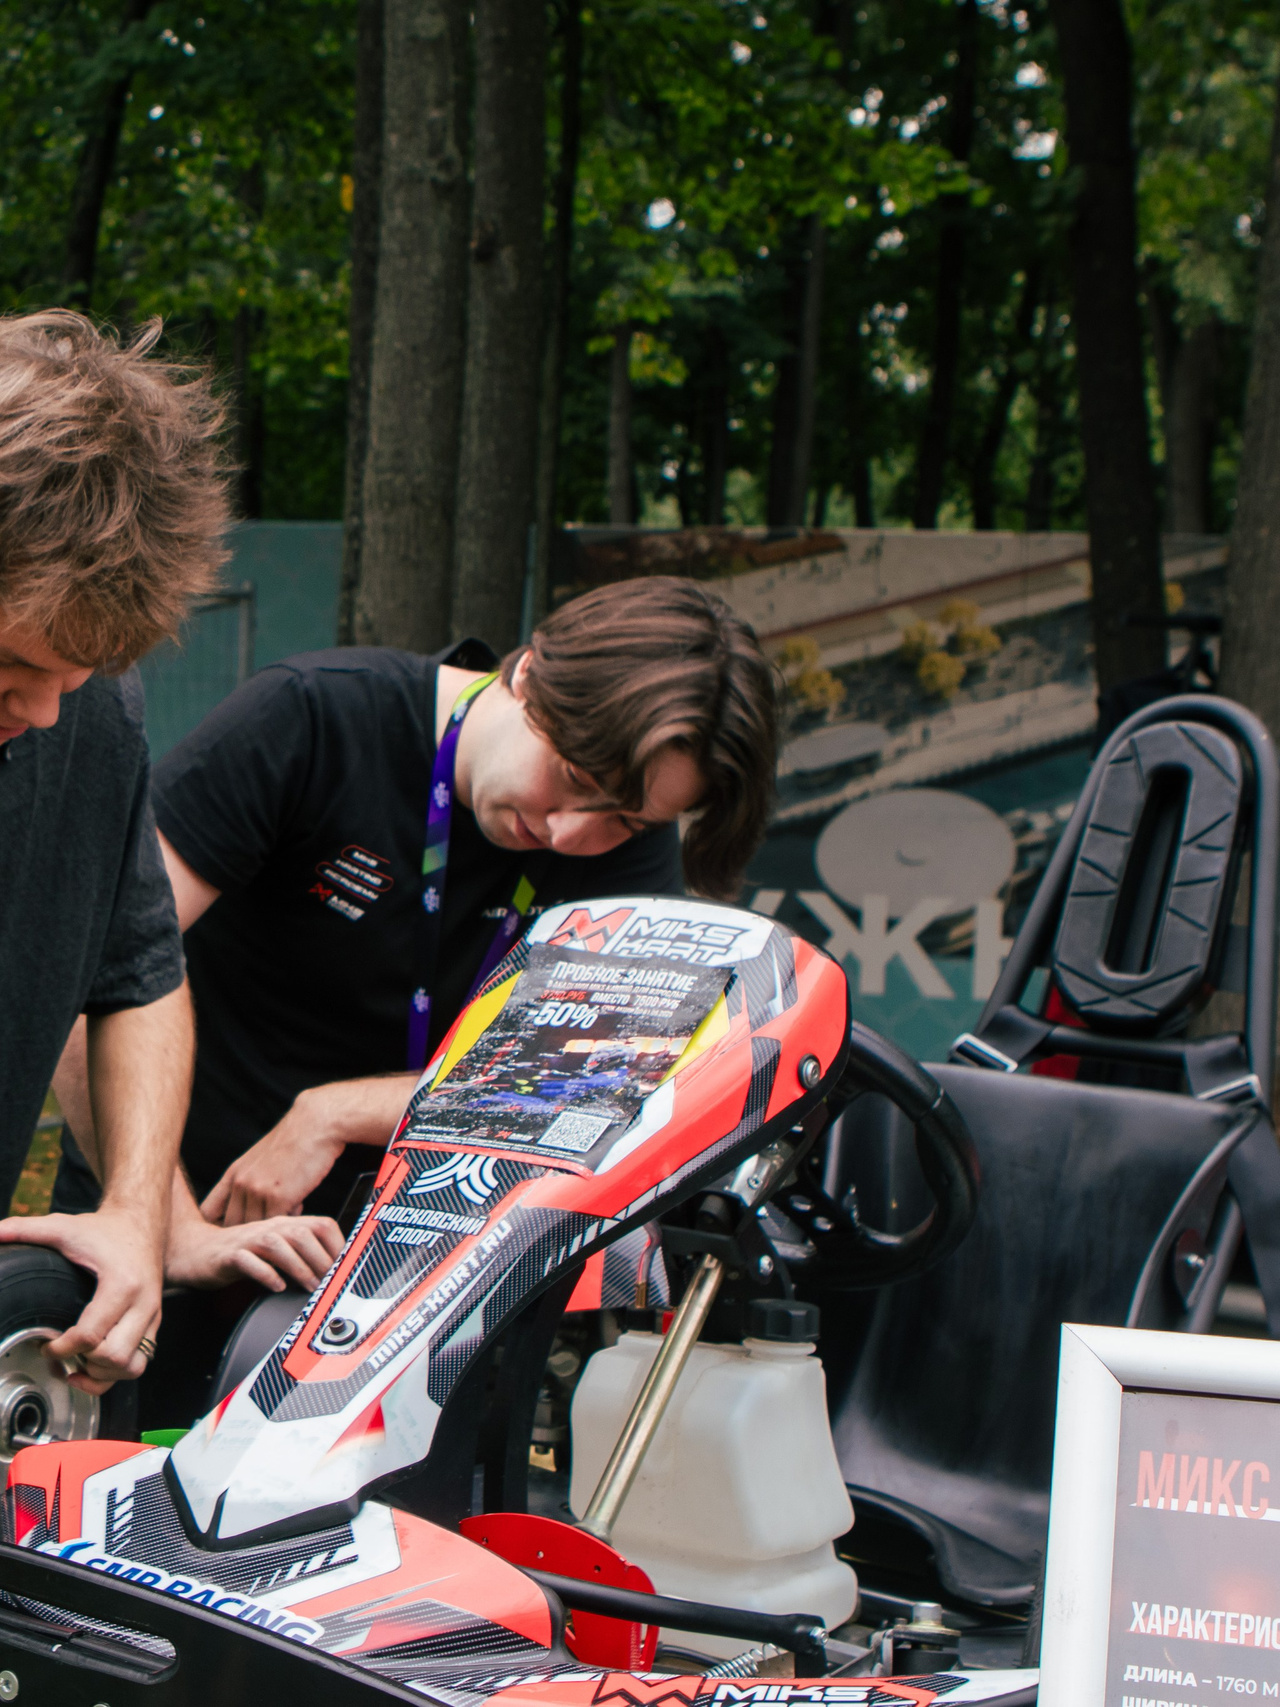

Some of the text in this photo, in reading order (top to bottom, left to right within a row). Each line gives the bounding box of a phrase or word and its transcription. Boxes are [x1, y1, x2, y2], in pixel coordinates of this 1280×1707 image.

[626, 917, 746, 946] MIKS
[552, 961, 698, 992] ПРОБНОЕ ЗАНЯТИЕ
[527, 1001, 599, 1030] -50%
[590, 992, 630, 1006] ВМЕСТО
[633, 994, 660, 1007] 7500
[659, 998, 681, 1010] РУБ
[373, 1204, 488, 1235] МОСКОВСКИЙ
[385, 1226, 444, 1249] СПОРТ
[367, 1219, 513, 1370] MIKS-KART.RU
[1135, 1450, 1271, 1520] МИКС
[711, 1684, 874, 1702] MIKS
[1123, 1664, 1198, 1687] ДЛИНА
[1216, 1675, 1258, 1695] 1760
